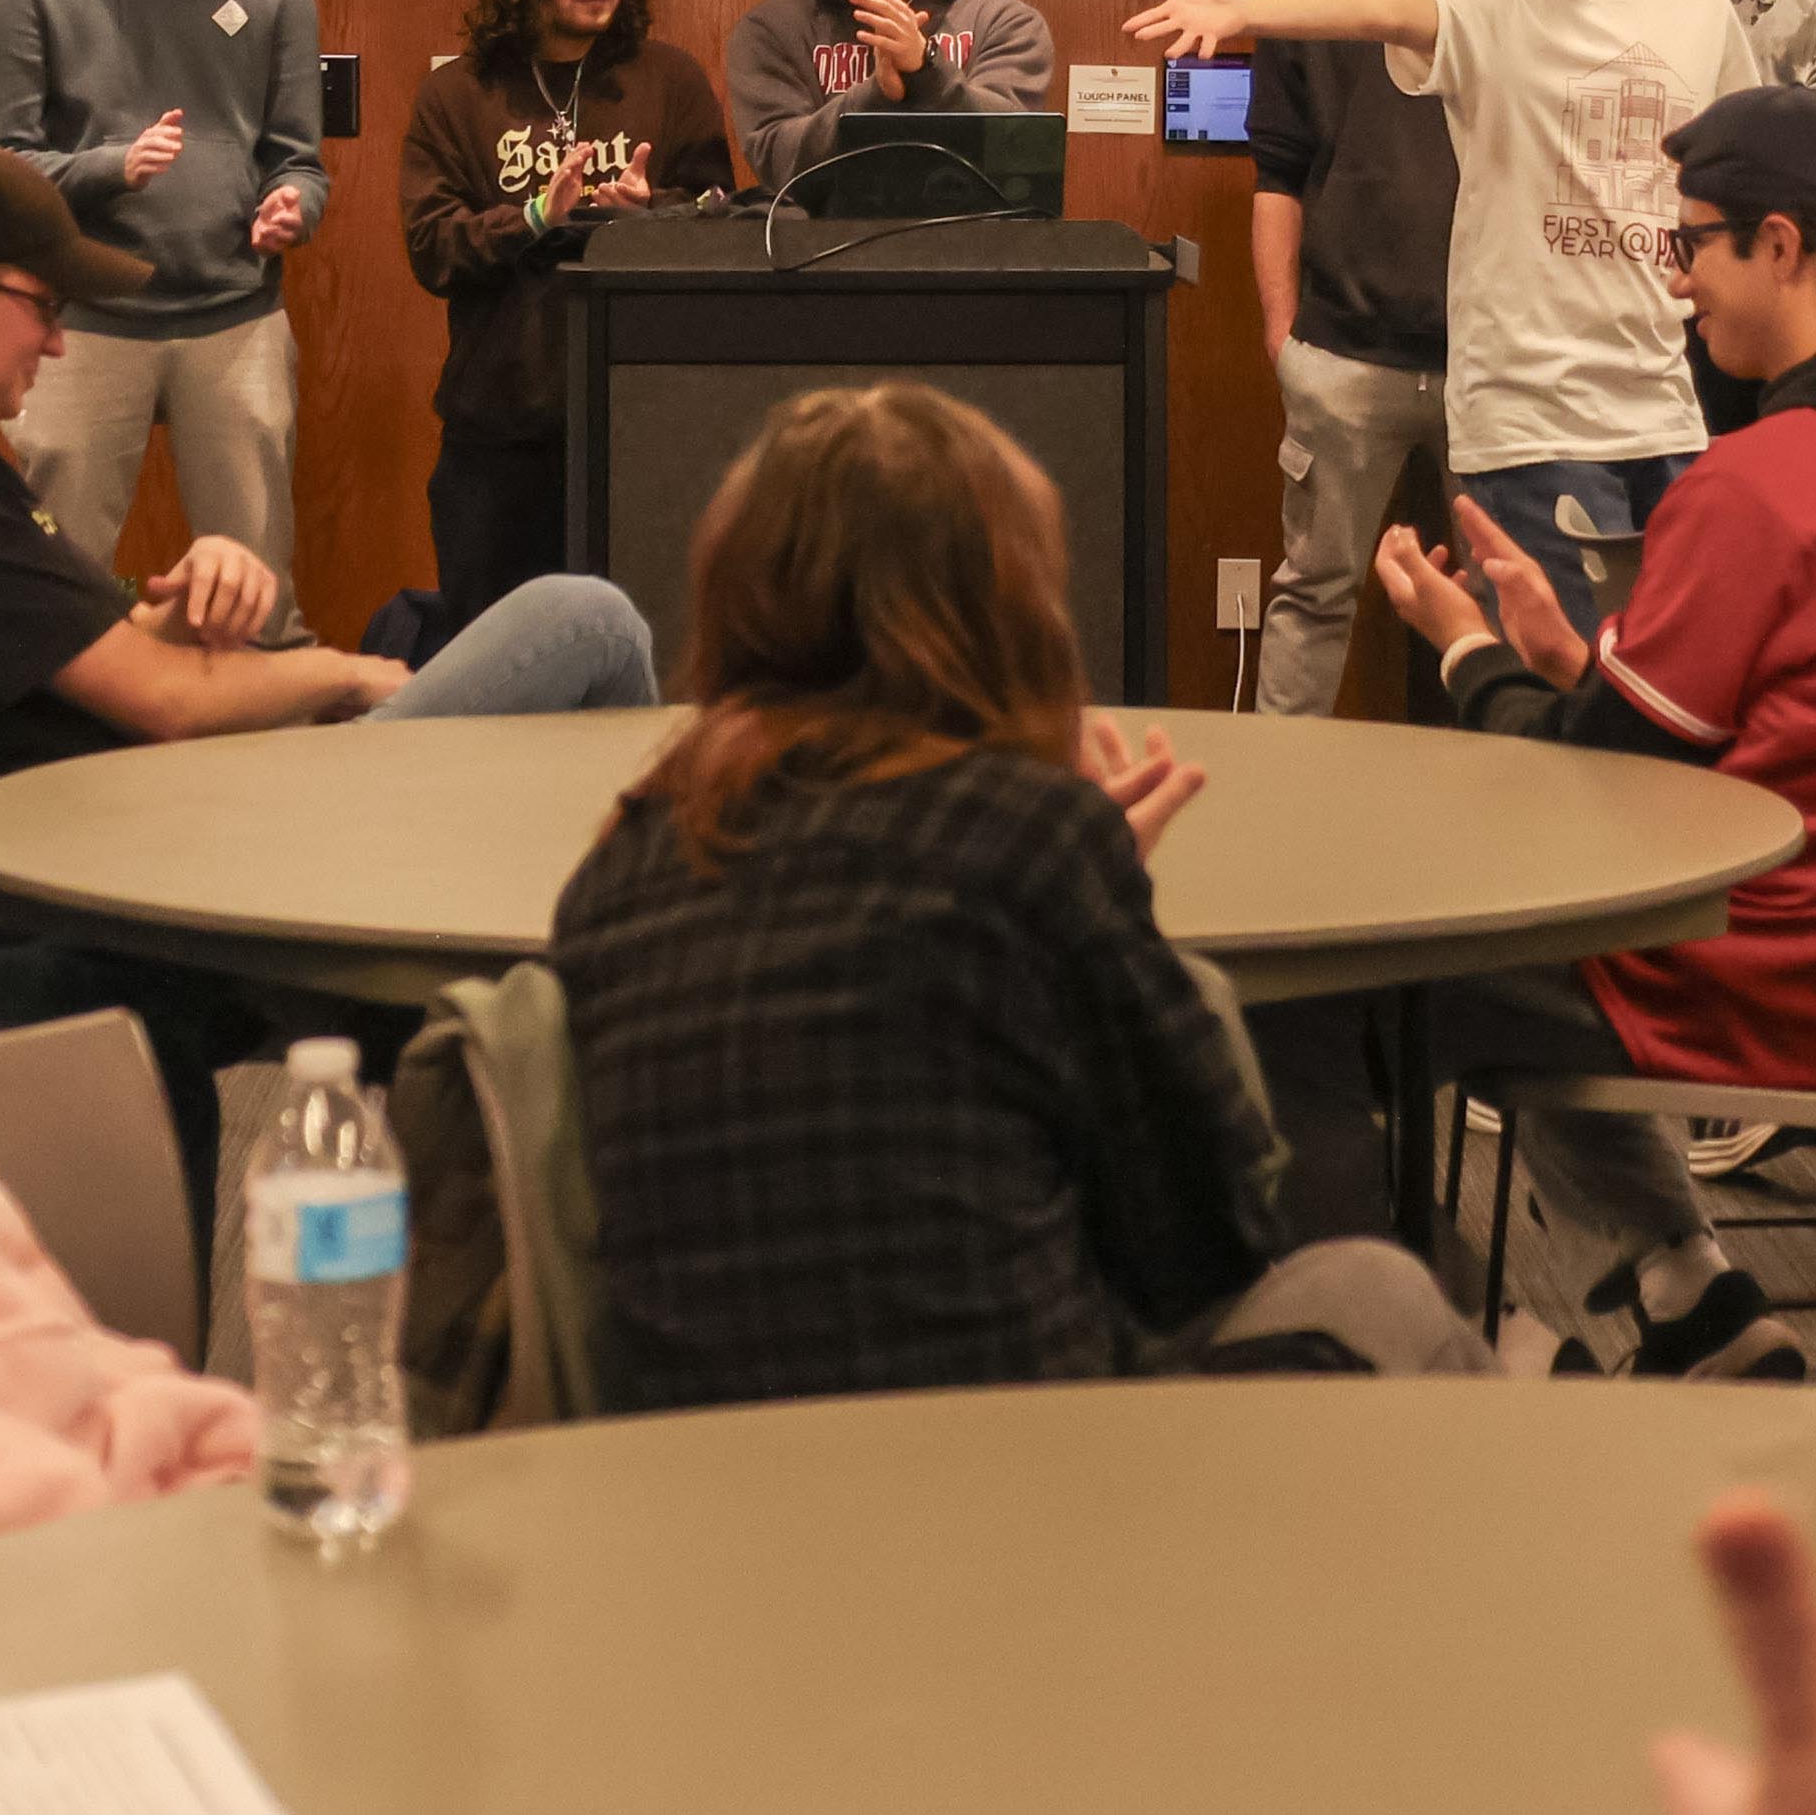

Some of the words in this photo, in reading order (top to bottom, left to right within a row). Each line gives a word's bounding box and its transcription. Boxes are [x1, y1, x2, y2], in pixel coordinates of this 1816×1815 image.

[1077, 91, 1115, 102] TOUCH
[1116, 92, 1151, 103] PANEL
[1543, 213, 1617, 238] FIRST
[1543, 234, 1616, 259] YEAR
